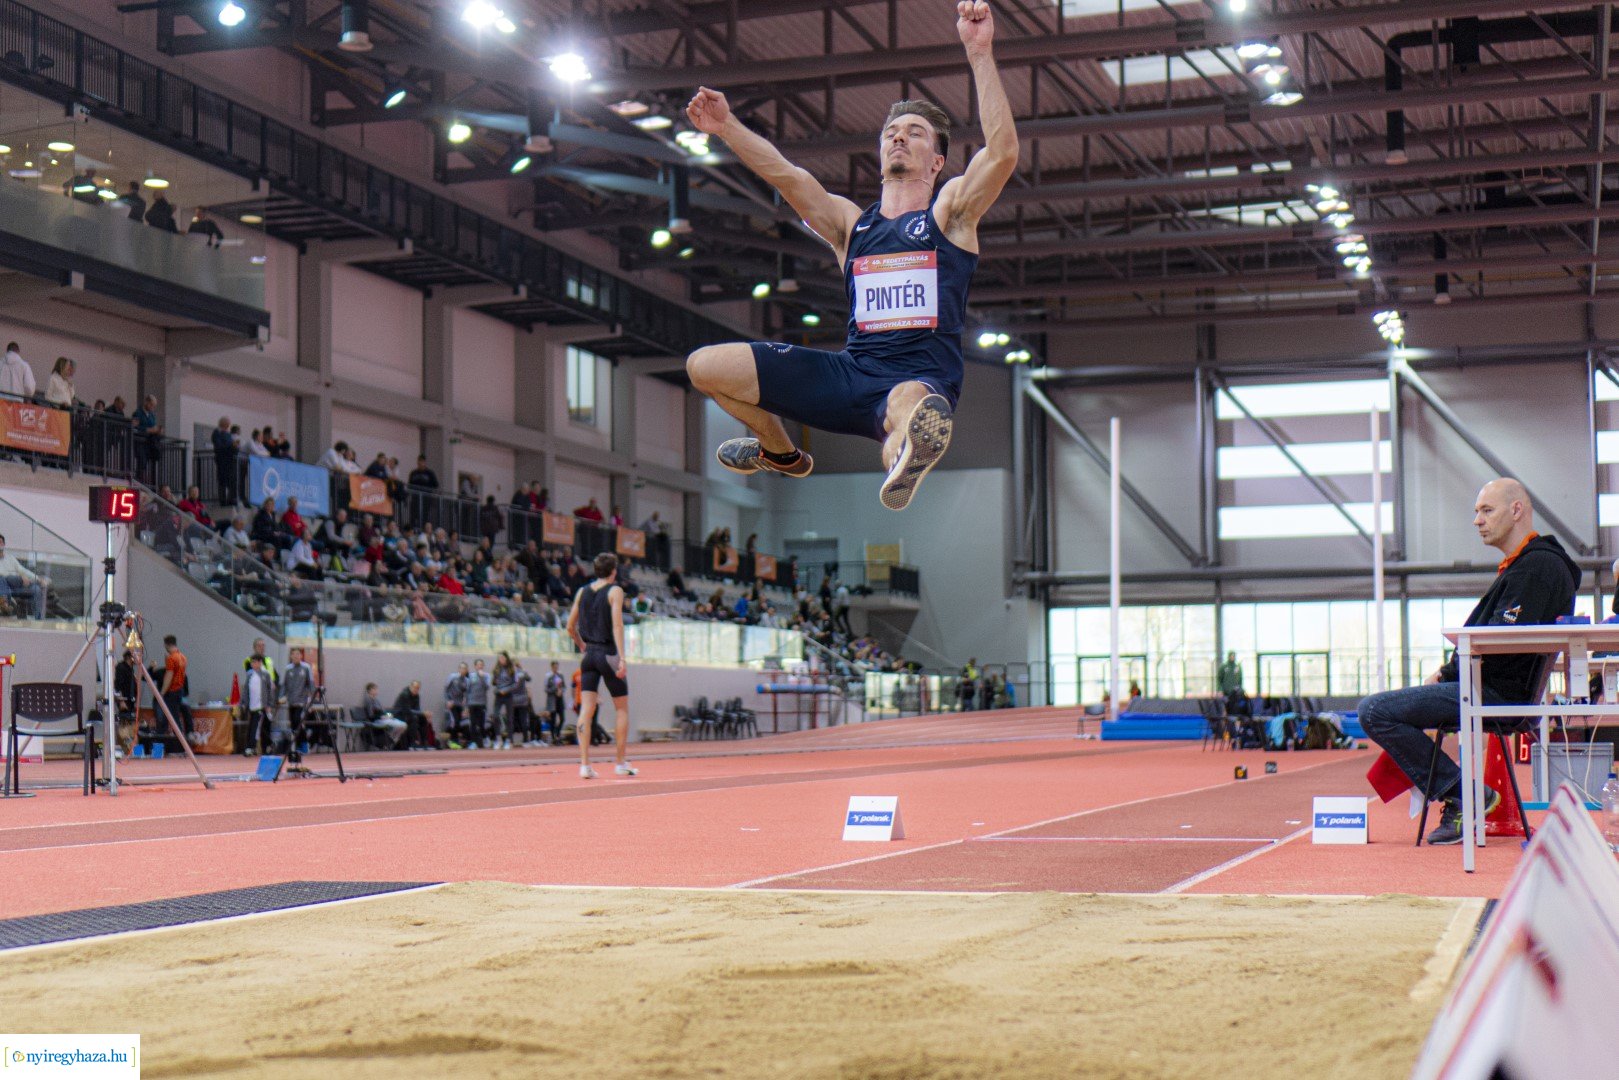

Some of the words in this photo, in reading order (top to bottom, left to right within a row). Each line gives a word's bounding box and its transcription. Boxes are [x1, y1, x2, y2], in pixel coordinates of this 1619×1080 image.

[866, 280, 925, 311] PINTÉR
[865, 320, 911, 330] NYÍREGYHÁZA
[111, 493, 134, 517] 15
[859, 813, 890, 823] polanik
[1329, 816, 1363, 826] polanik
